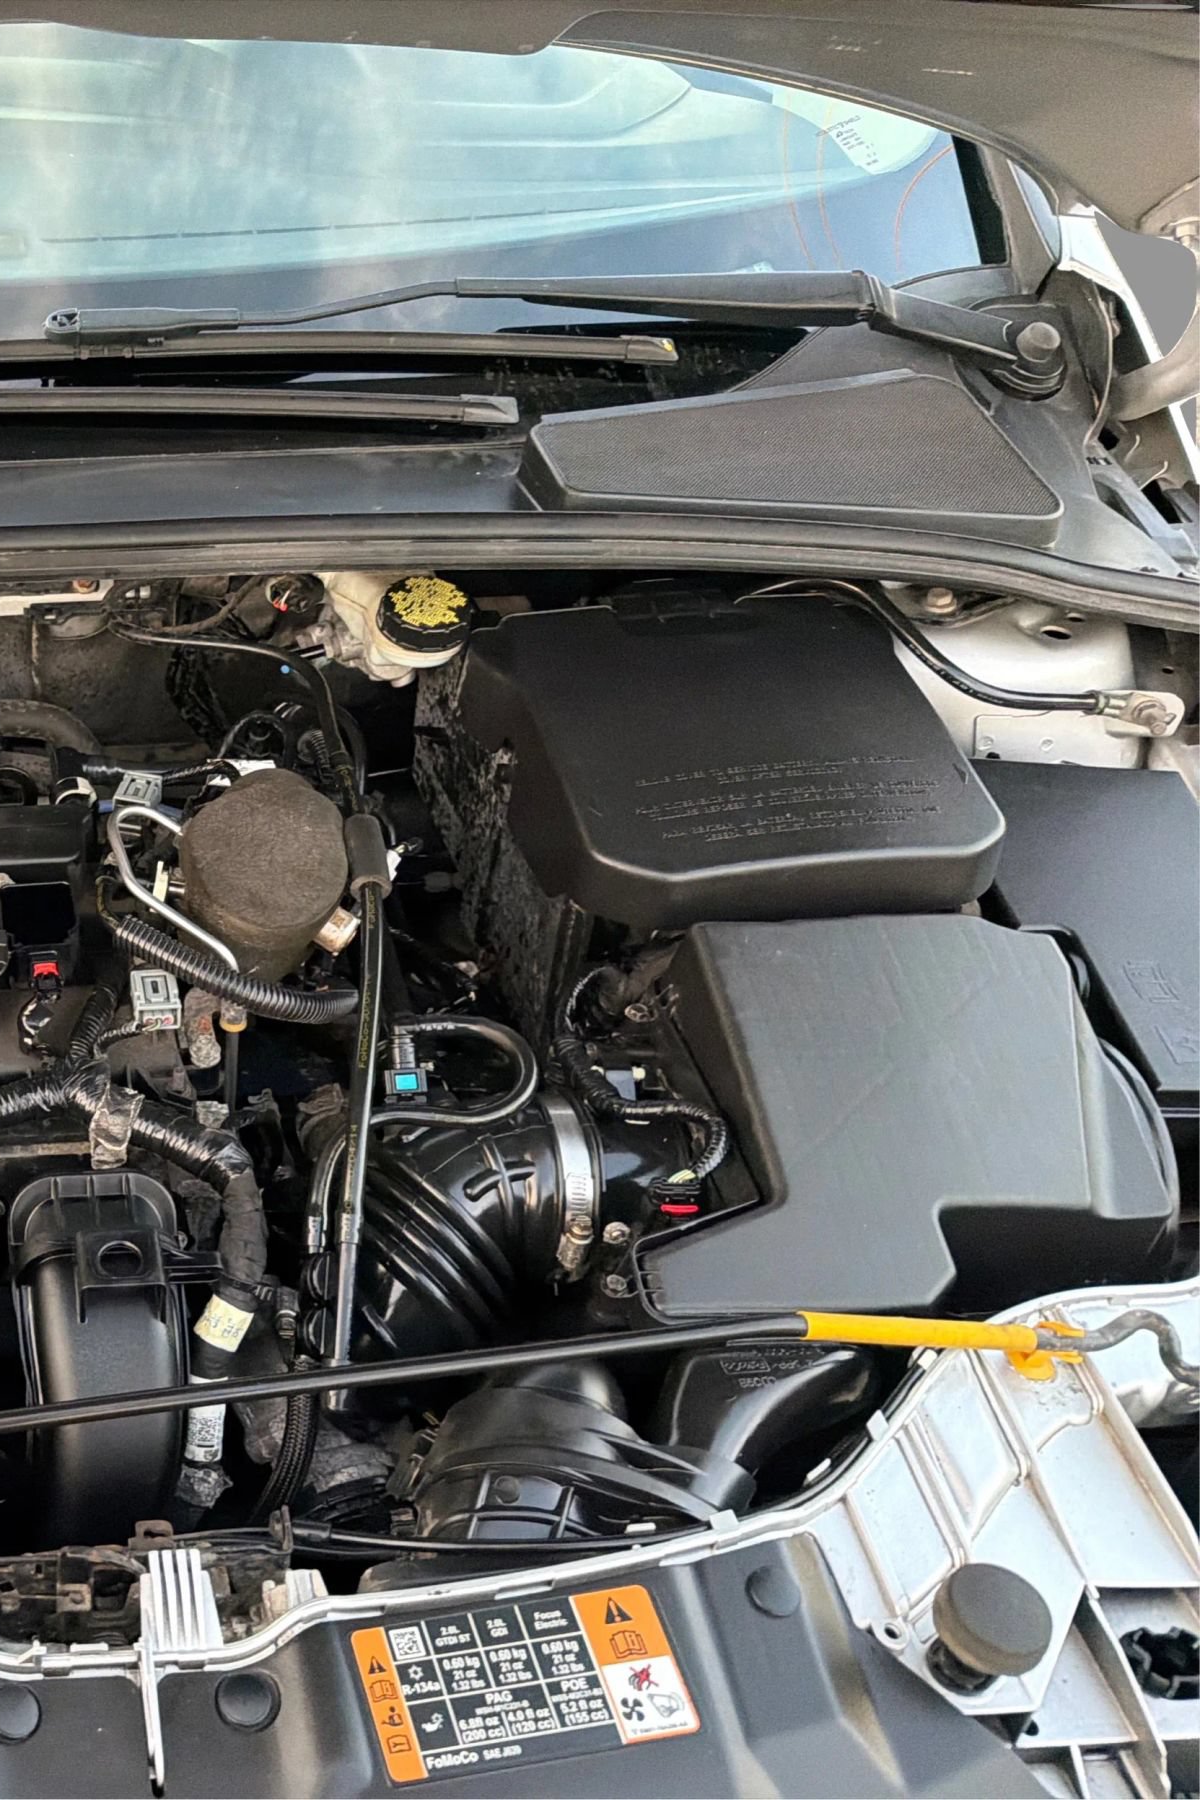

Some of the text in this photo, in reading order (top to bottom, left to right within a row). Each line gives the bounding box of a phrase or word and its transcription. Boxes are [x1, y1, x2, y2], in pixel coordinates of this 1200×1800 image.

[533, 1610, 562, 1621] Focus
[533, 1618, 569, 1631] Electric
[459, 1633, 471, 1644] ST
[541, 1639, 580, 1655] 0.60 kg
[489, 1647, 527, 1663] 0.60 kg
[552, 1653, 577, 1665] 21 oz
[442, 1656, 481, 1671] 0.60 kg
[500, 1661, 525, 1673] 21 oz
[551, 1662, 586, 1676] 1.32 lbs
[452, 1669, 478, 1680] 21 oz
[499, 1670, 533, 1684] 1.32 lbs
[402, 1680, 441, 1695] R-134a
[452, 1679, 486, 1692] 1.32 lbs
[560, 1677, 589, 1692] POE
[484, 1690, 513, 1705] PAG
[560, 1699, 604, 1714] 5.2 fl oz
[485, 1716, 500, 1727] oz
[507, 1708, 551, 1722] 4.0 fl oz
[564, 1709, 609, 1726] (155 cc)
[511, 1717, 555, 1735] (120 cc)
[462, 1726, 506, 1743] (200 cc)
[426, 1750, 480, 1769] FoMoCo
[482, 1747, 501, 1760] SAE
